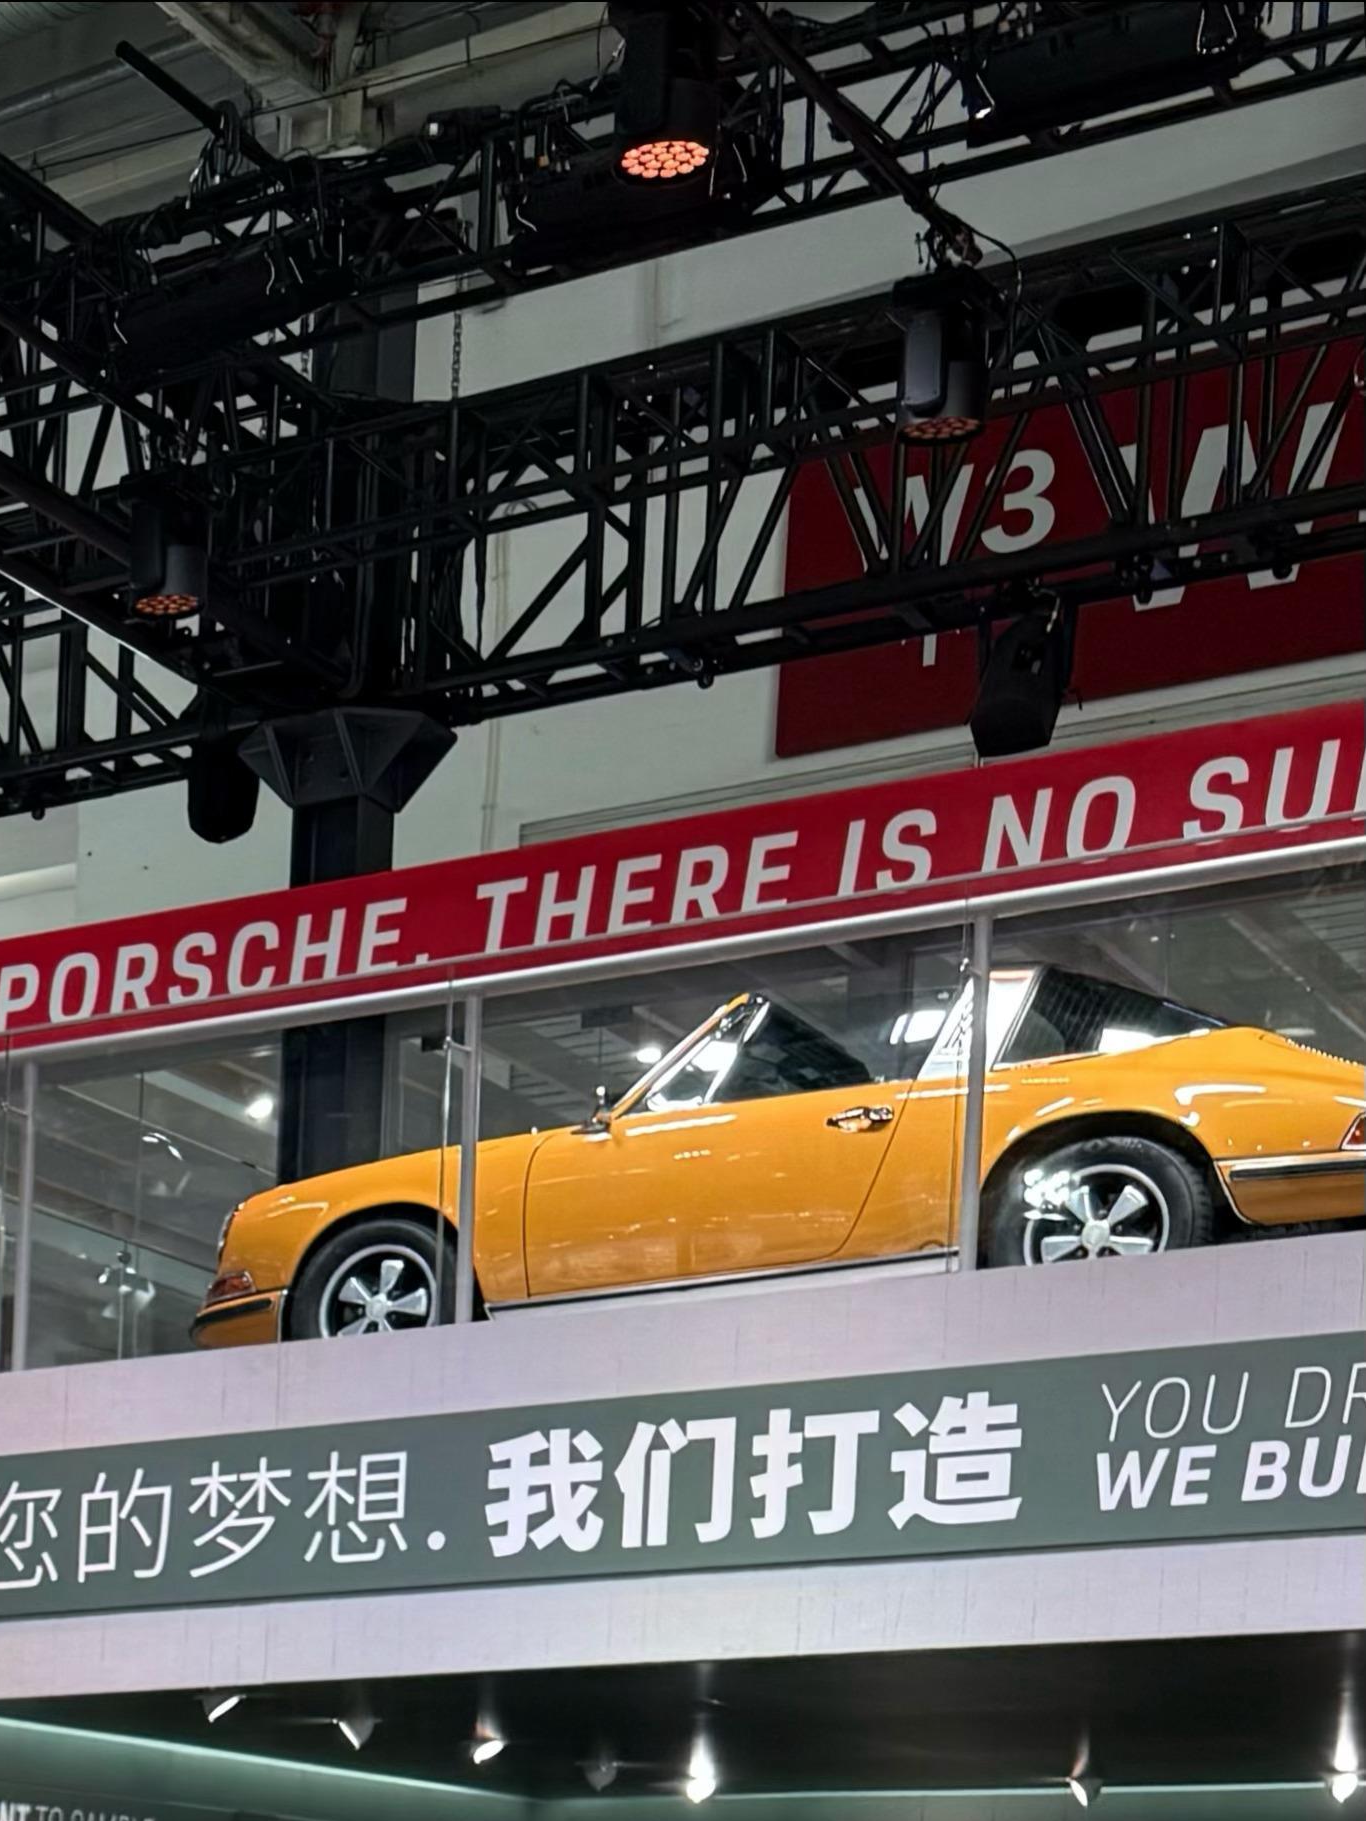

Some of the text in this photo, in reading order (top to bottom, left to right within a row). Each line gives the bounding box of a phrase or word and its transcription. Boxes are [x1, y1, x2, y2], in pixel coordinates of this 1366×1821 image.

[476, 830, 800, 958] THERE
[838, 807, 942, 898] IS
[980, 772, 1136, 866] NO
[1101, 1371, 1250, 1442] YOU
[484, 1390, 1022, 1558] 我们打造
[1096, 1444, 1218, 1512] WE
